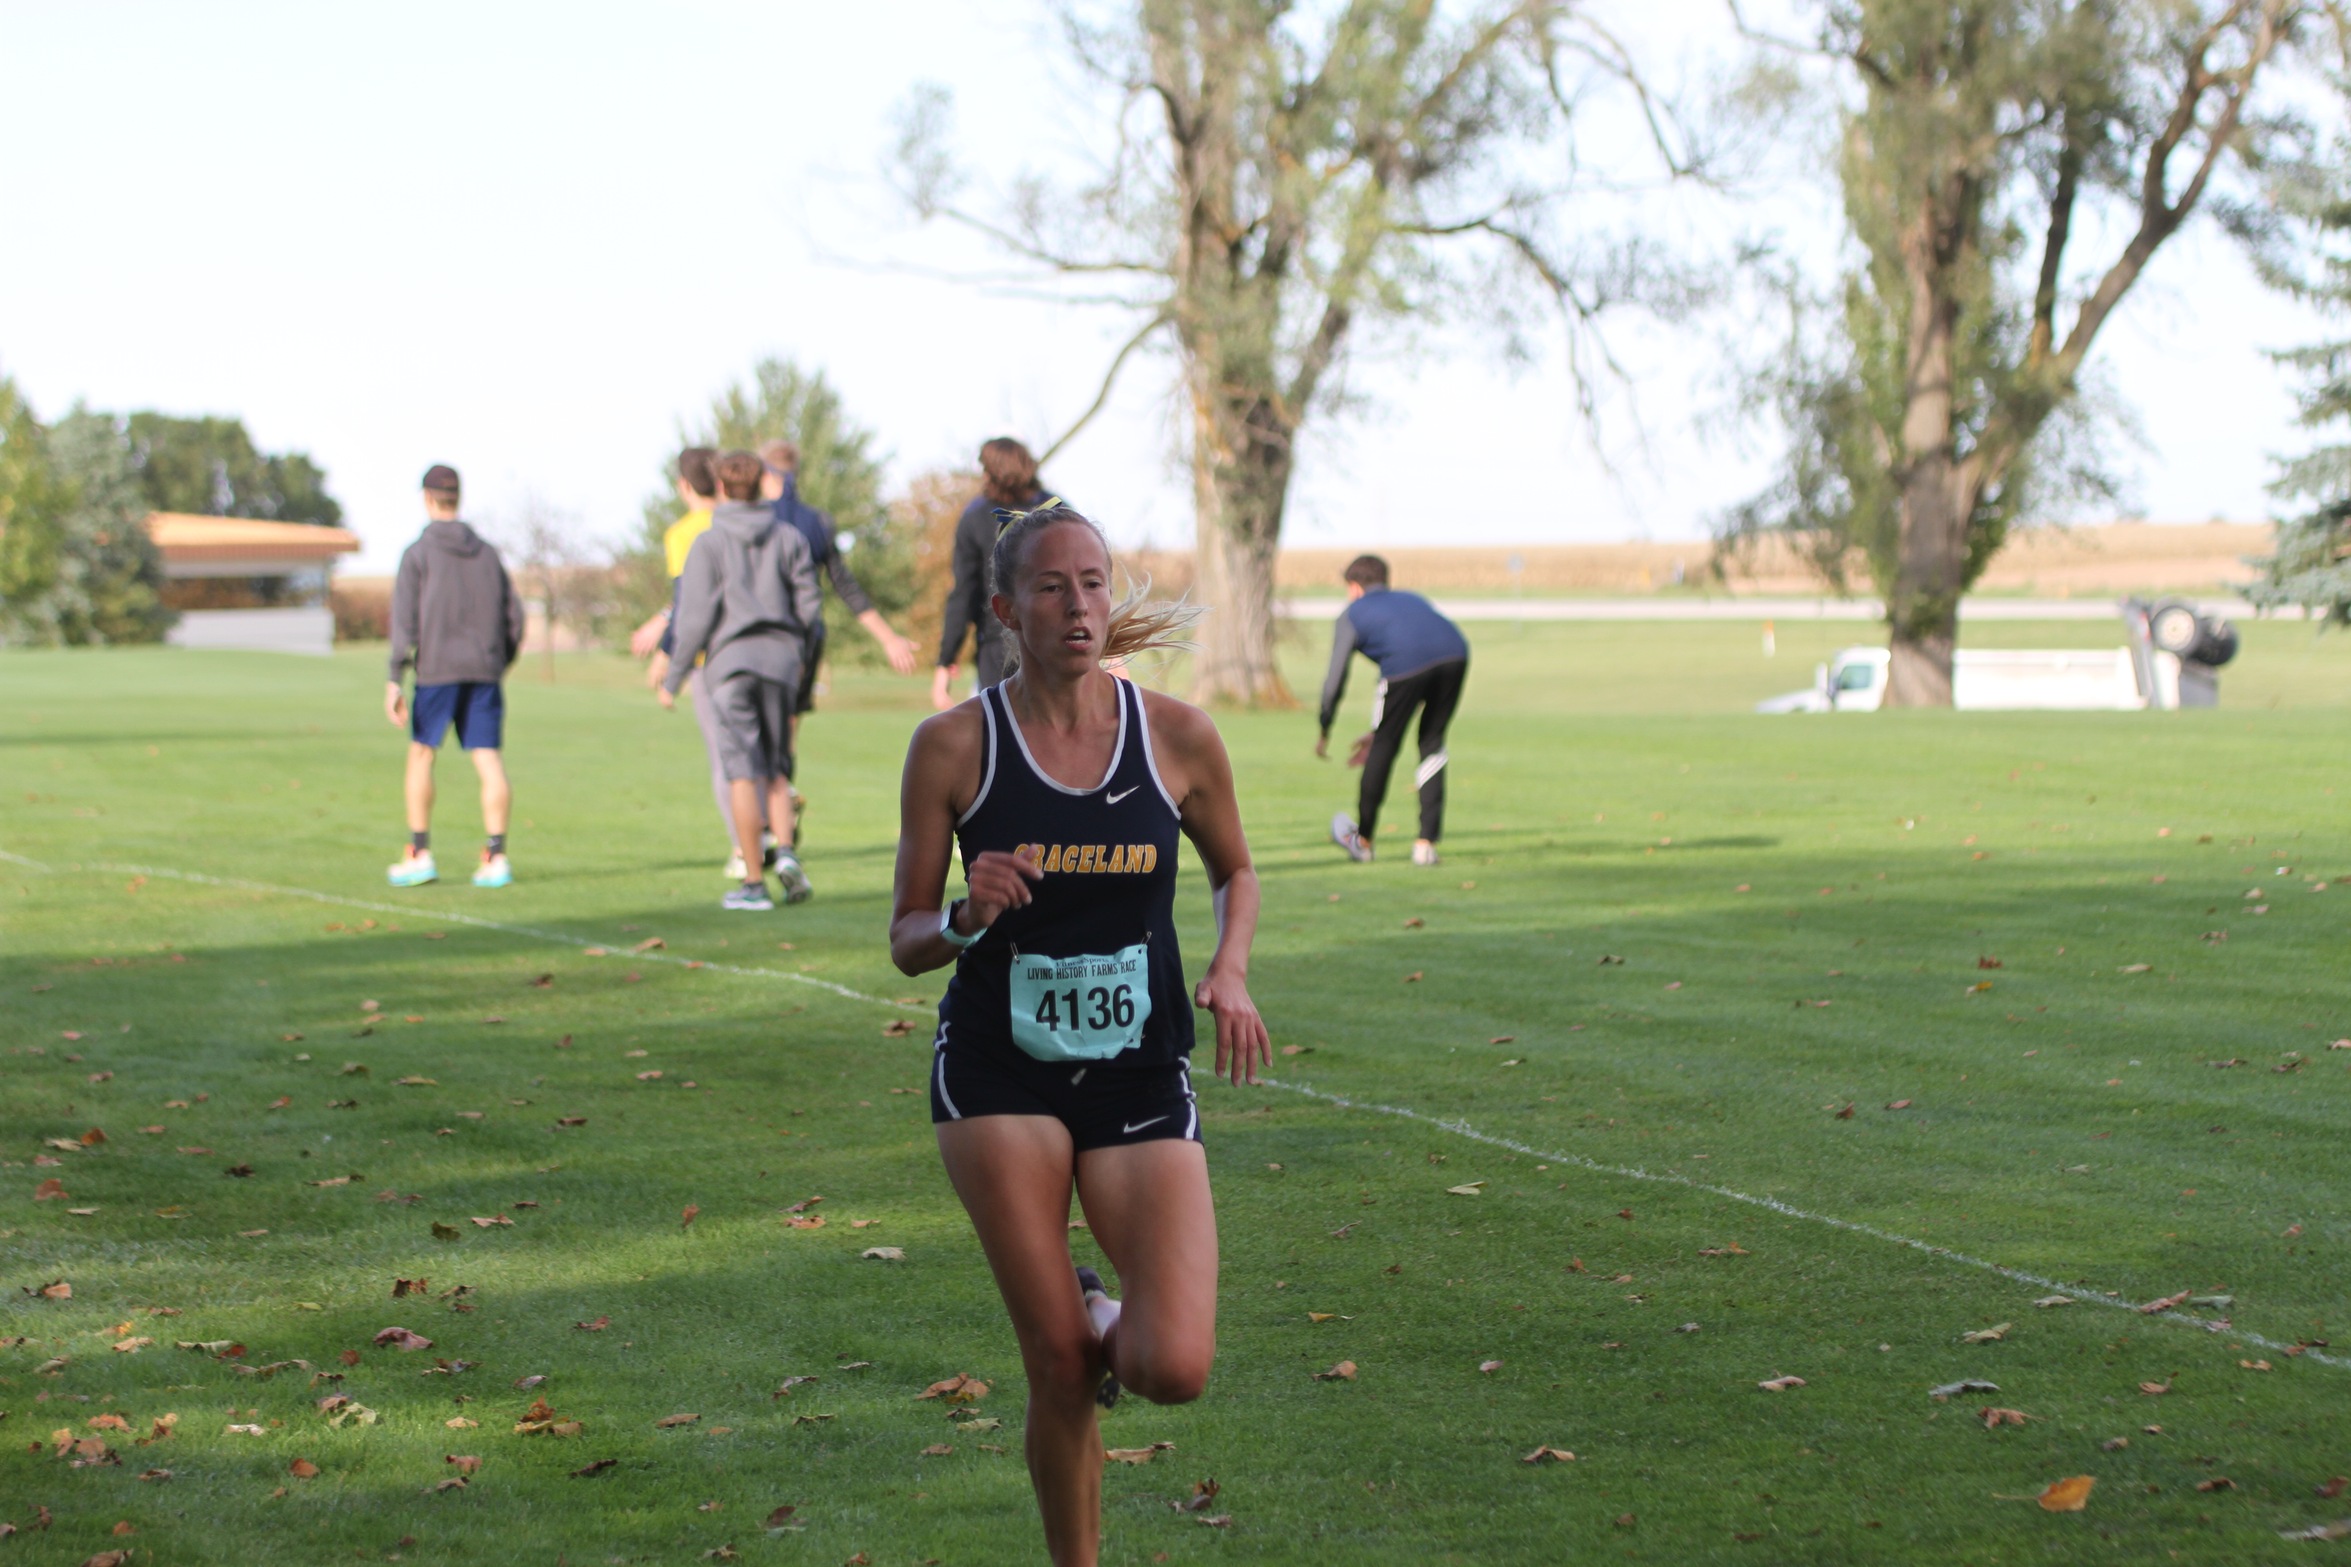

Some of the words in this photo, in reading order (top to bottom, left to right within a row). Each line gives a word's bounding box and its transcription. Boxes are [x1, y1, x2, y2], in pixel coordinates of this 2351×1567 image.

[1027, 967, 1054, 980] LIVING
[1056, 965, 1088, 980] HISTORY
[1091, 963, 1119, 977] FARMS
[1120, 959, 1137, 974] RACE
[1035, 983, 1135, 1032] 4136
